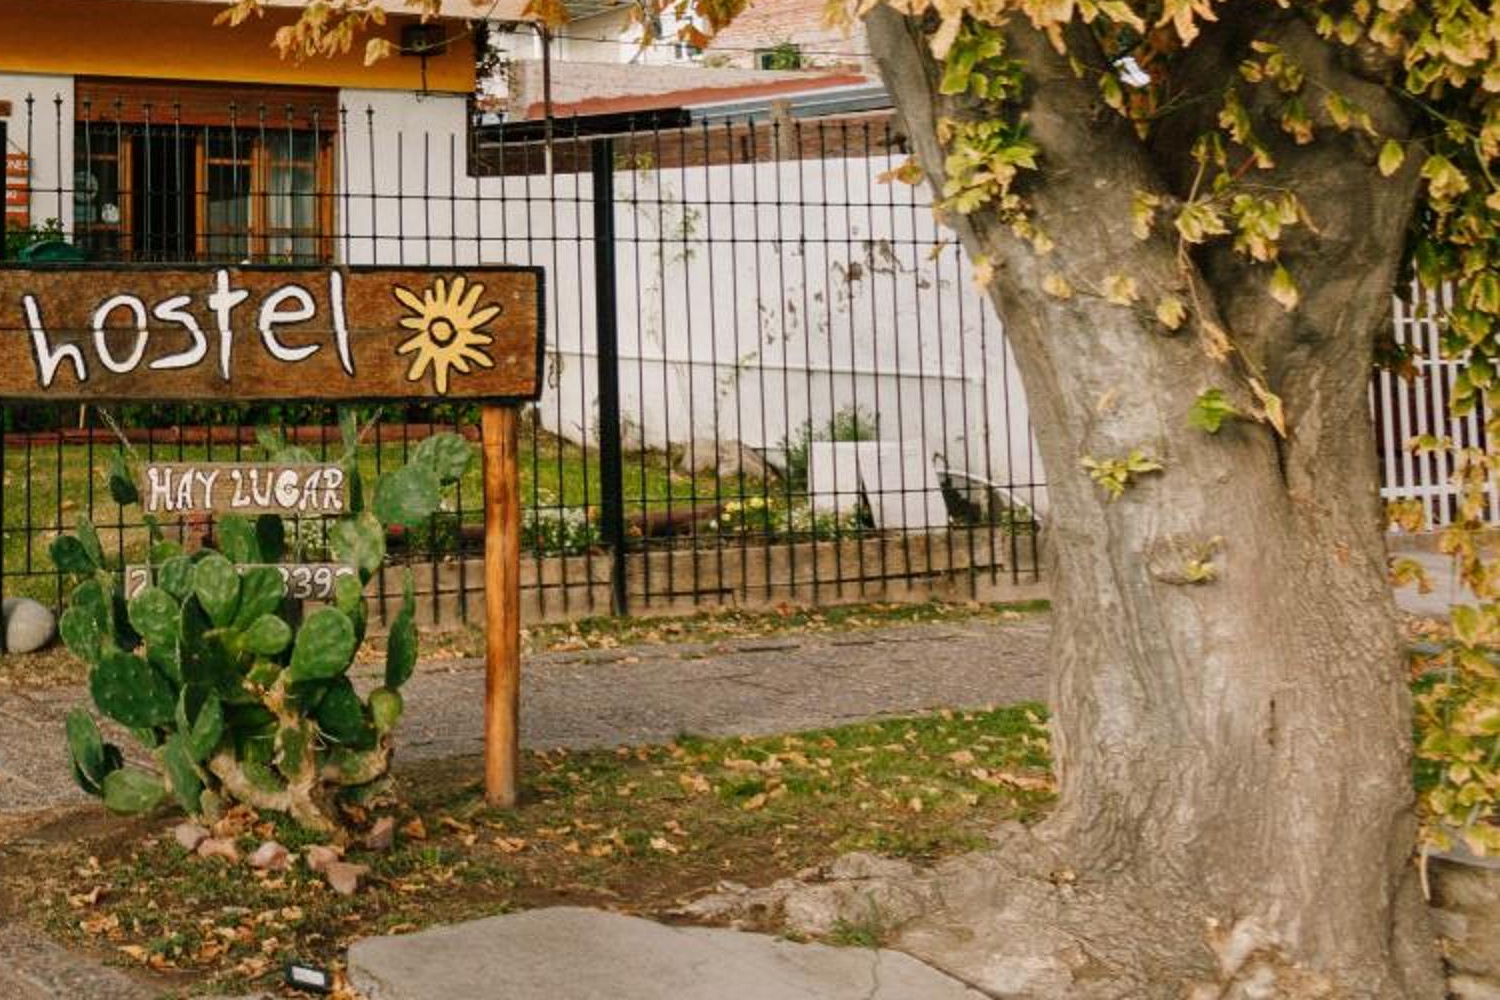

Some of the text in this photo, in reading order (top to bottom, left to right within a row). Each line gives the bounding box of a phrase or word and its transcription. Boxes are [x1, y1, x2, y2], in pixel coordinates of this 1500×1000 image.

[23, 269, 355, 388] hostel
[148, 466, 344, 512] HAY LUGAR
